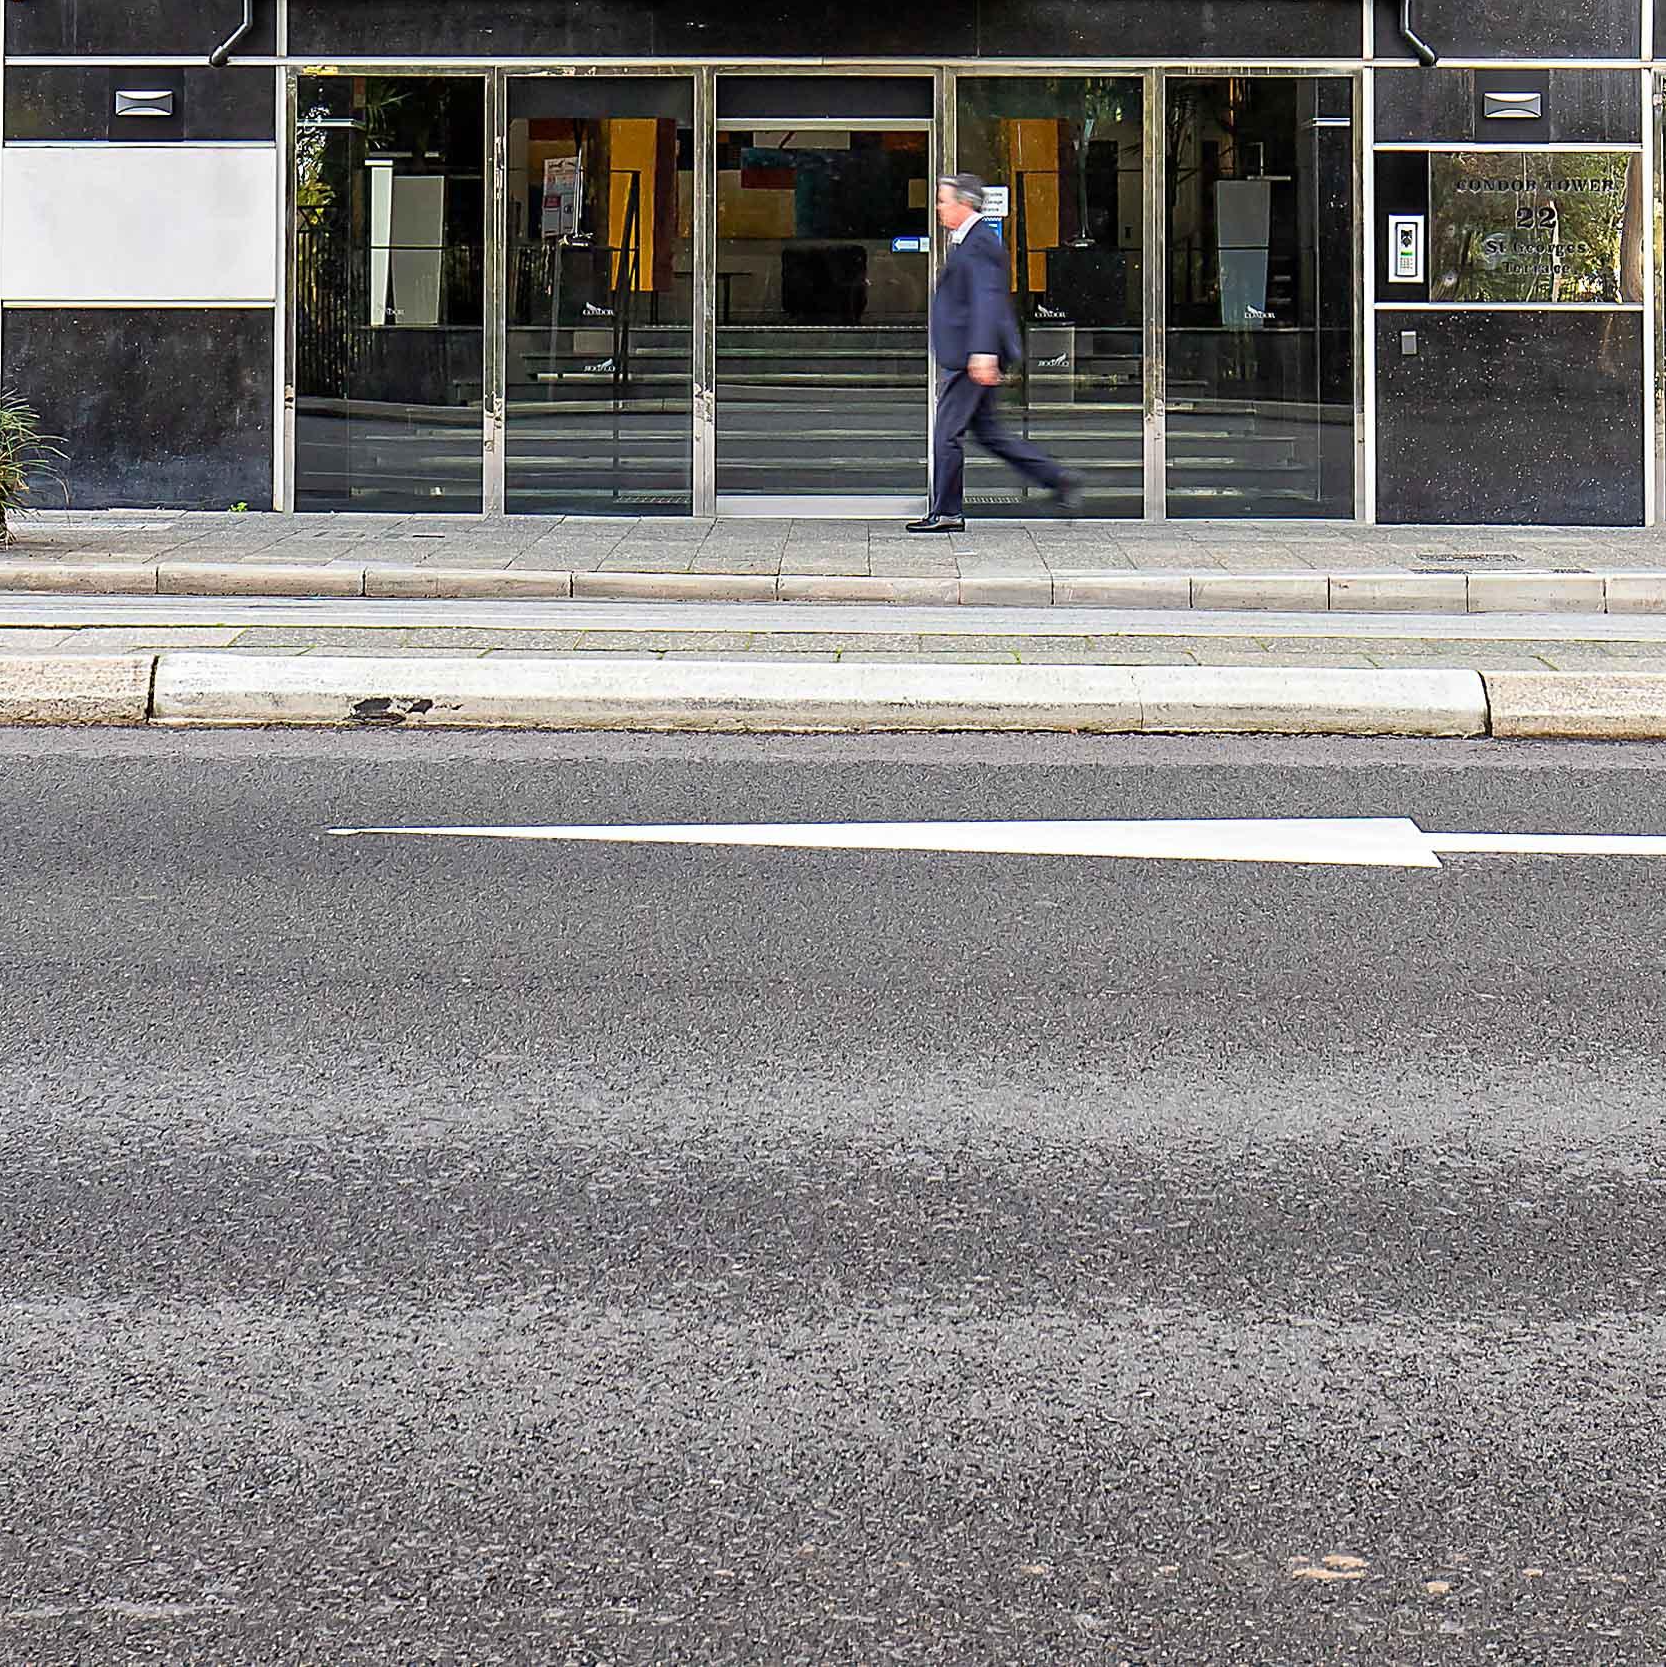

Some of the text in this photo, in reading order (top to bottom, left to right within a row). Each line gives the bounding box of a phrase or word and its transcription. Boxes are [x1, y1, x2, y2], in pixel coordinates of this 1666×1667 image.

[1456, 178, 1617, 193] CONDOR TOWER
[1517, 206, 1557, 229] 22
[1485, 239, 1588, 259] St Georges
[1503, 261, 1571, 274] Terrace
